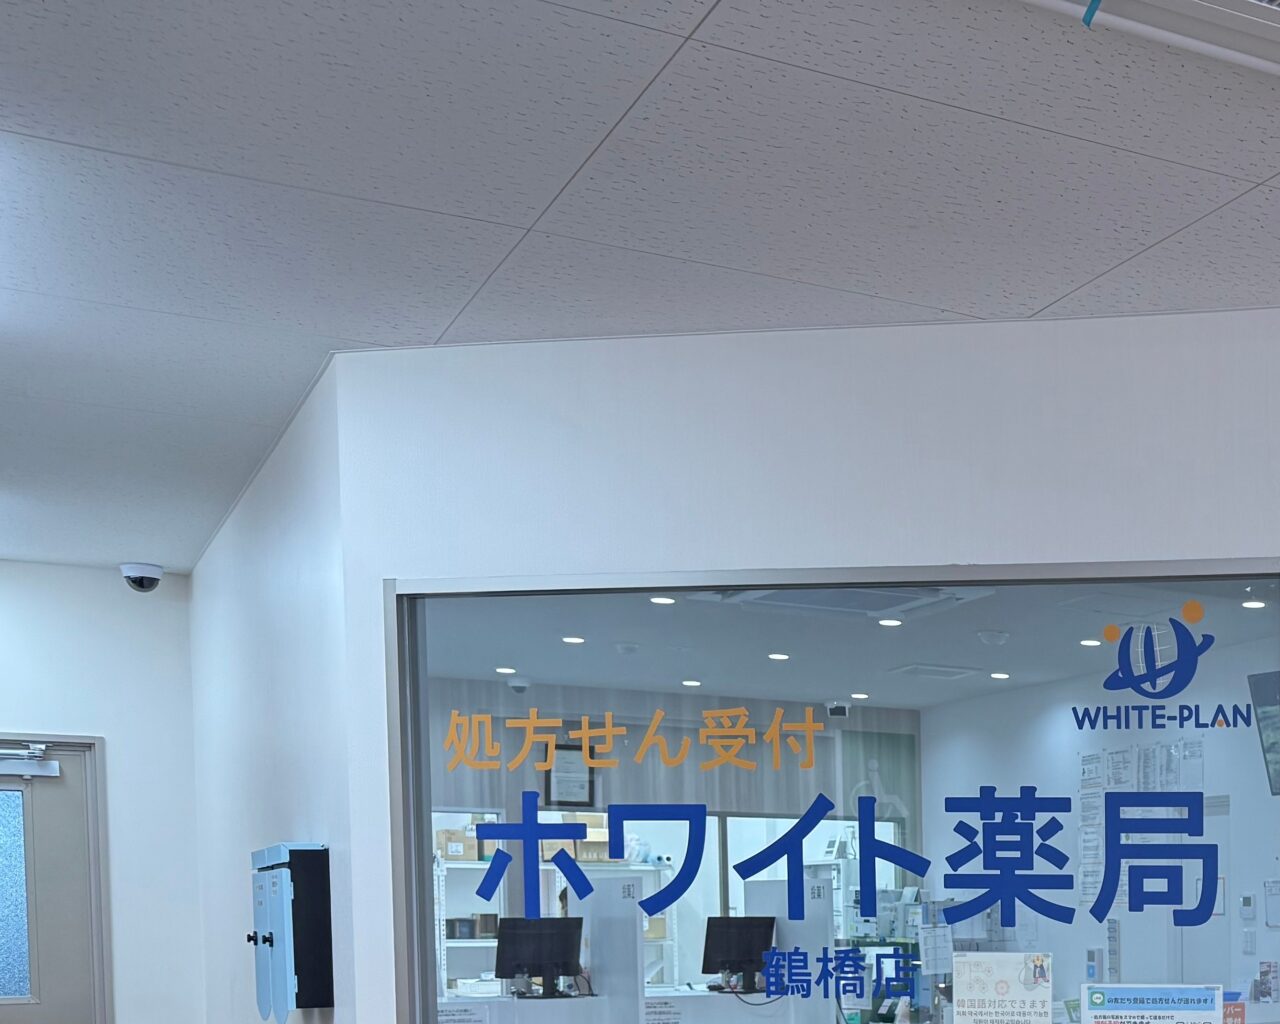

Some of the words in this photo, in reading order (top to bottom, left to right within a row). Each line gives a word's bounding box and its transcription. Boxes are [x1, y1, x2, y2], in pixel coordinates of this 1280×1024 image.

[444, 707, 824, 772] 処方せん受付
[1072, 704, 1252, 730] WHITE-PLAN
[475, 786, 1219, 928] ホワイト薬局
[761, 946, 918, 1002] 鶴橋店
